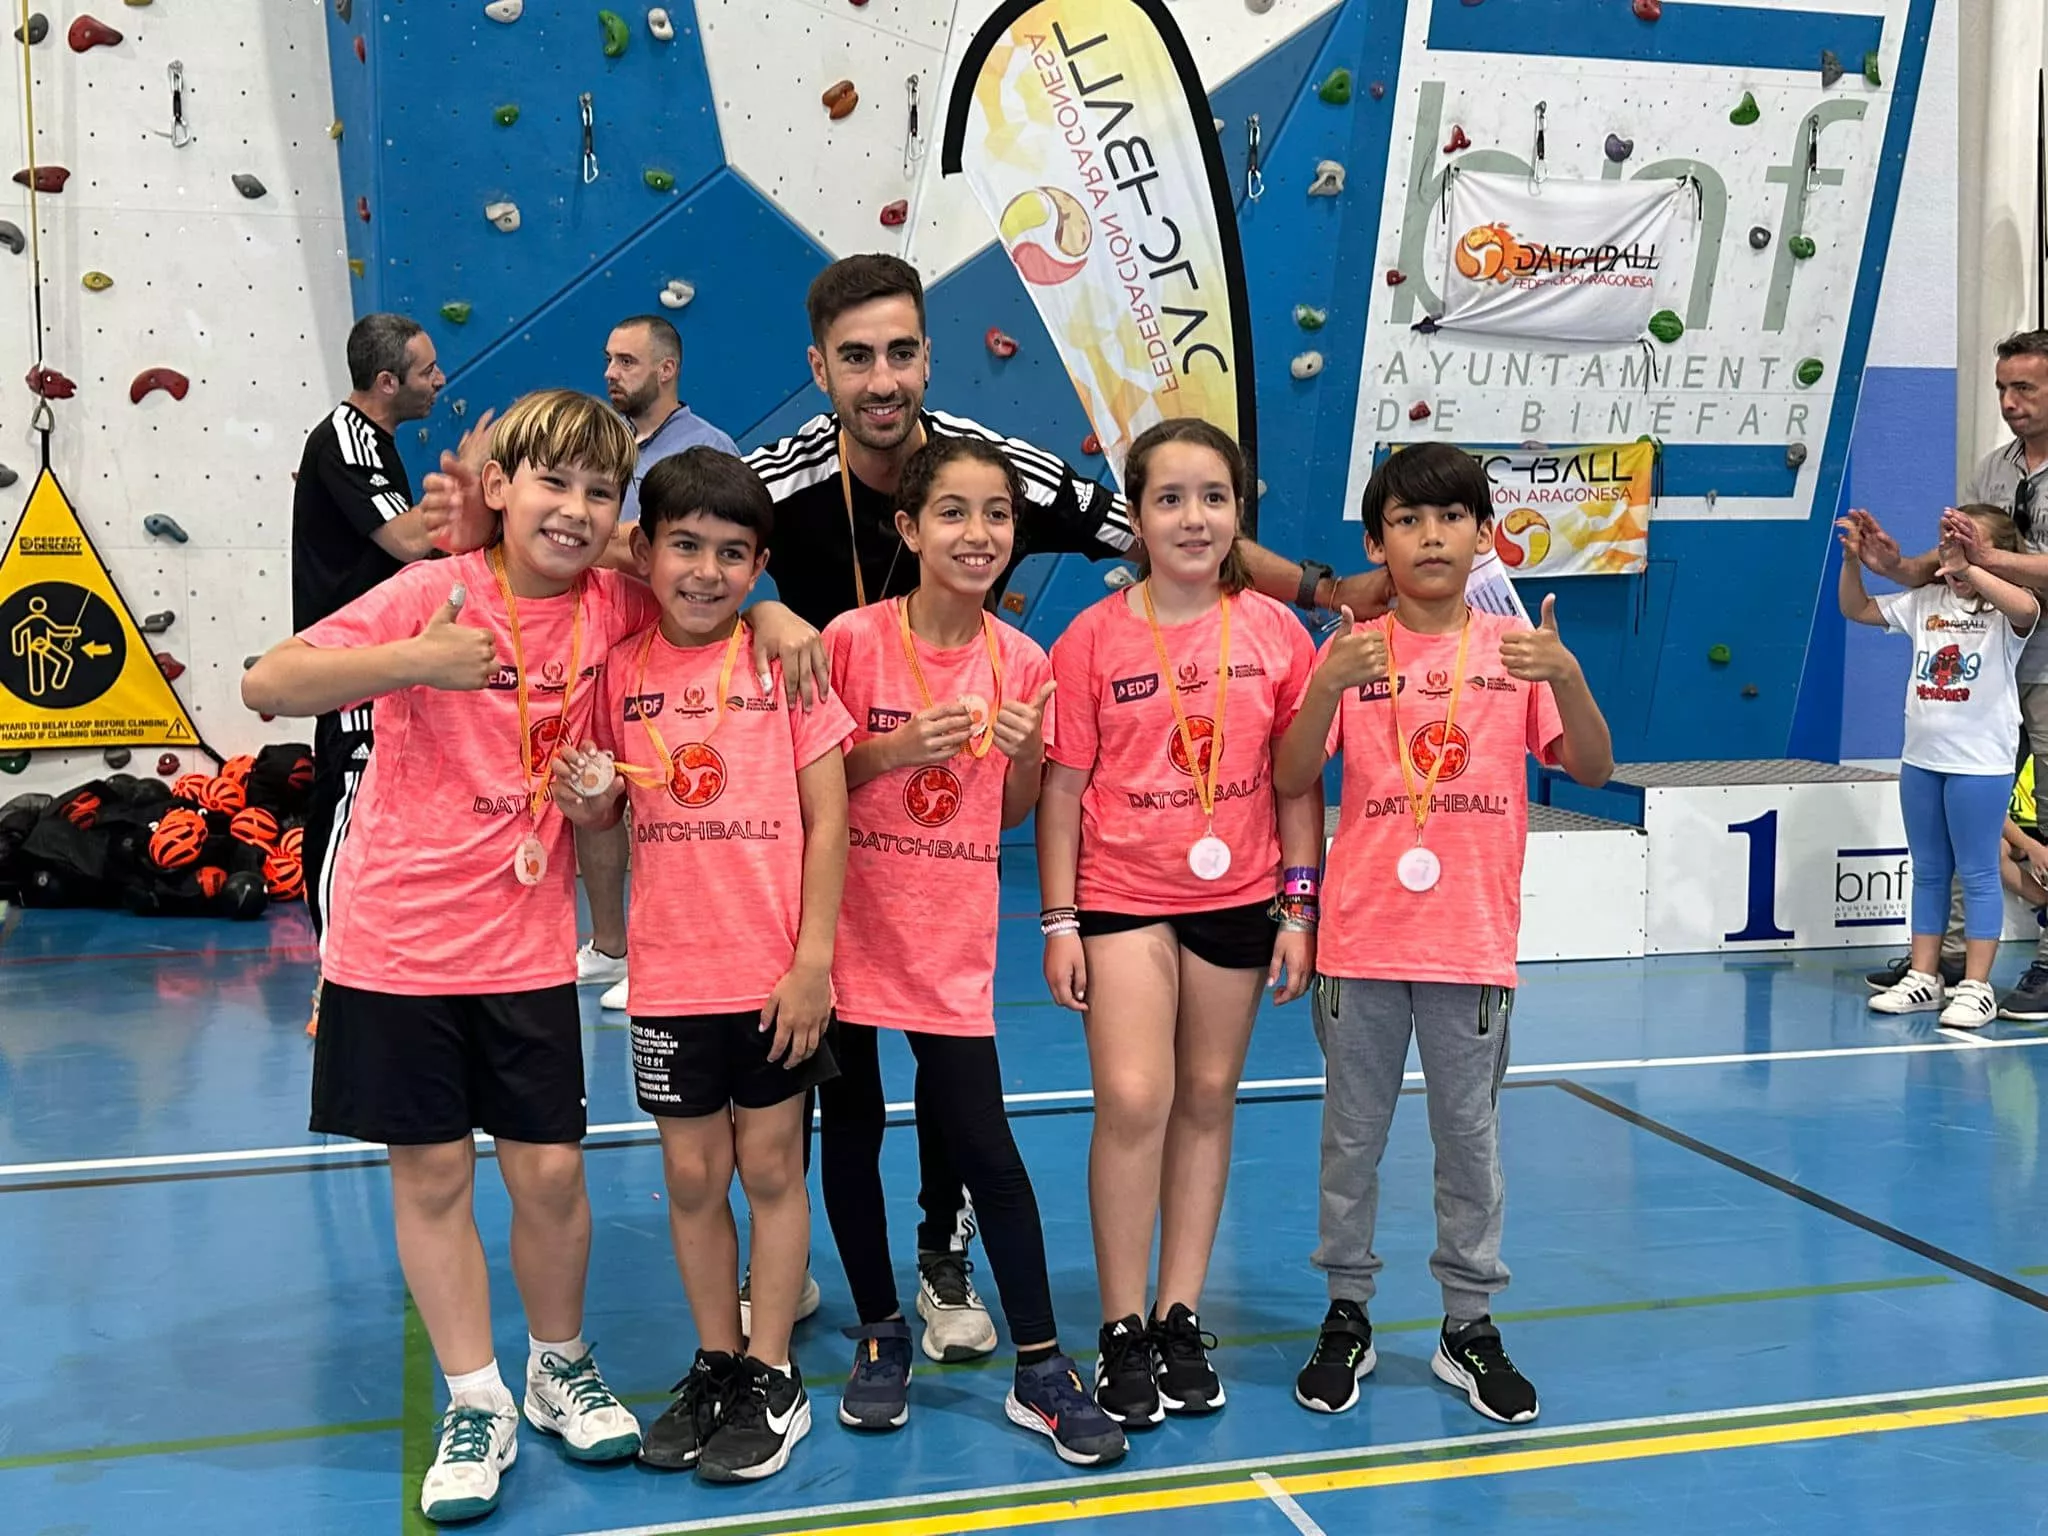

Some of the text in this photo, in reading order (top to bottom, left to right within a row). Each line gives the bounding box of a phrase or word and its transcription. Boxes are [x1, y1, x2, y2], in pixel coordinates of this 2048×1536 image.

[1376, 399, 1809, 435] DE BINEFAR
[1527, 486, 1633, 504] ARAGONESA
[33, 542, 82, 550] DESCENT
[1127, 679, 1154, 696] EDF
[637, 698, 661, 714] DF
[30, 721, 41, 730] TO
[42, 720, 69, 729] BELAY
[70, 720, 92, 729] LOOP
[94, 719, 125, 728] BEFORE
[128, 718, 168, 727] CLIMBING
[1, 728, 144, 740] HAZARD IF CLIMBING UNATTACHED
[849, 827, 997, 862] DATCHBALL
[1725, 810, 1794, 942] 1
[1836, 860, 1908, 902] bnf
